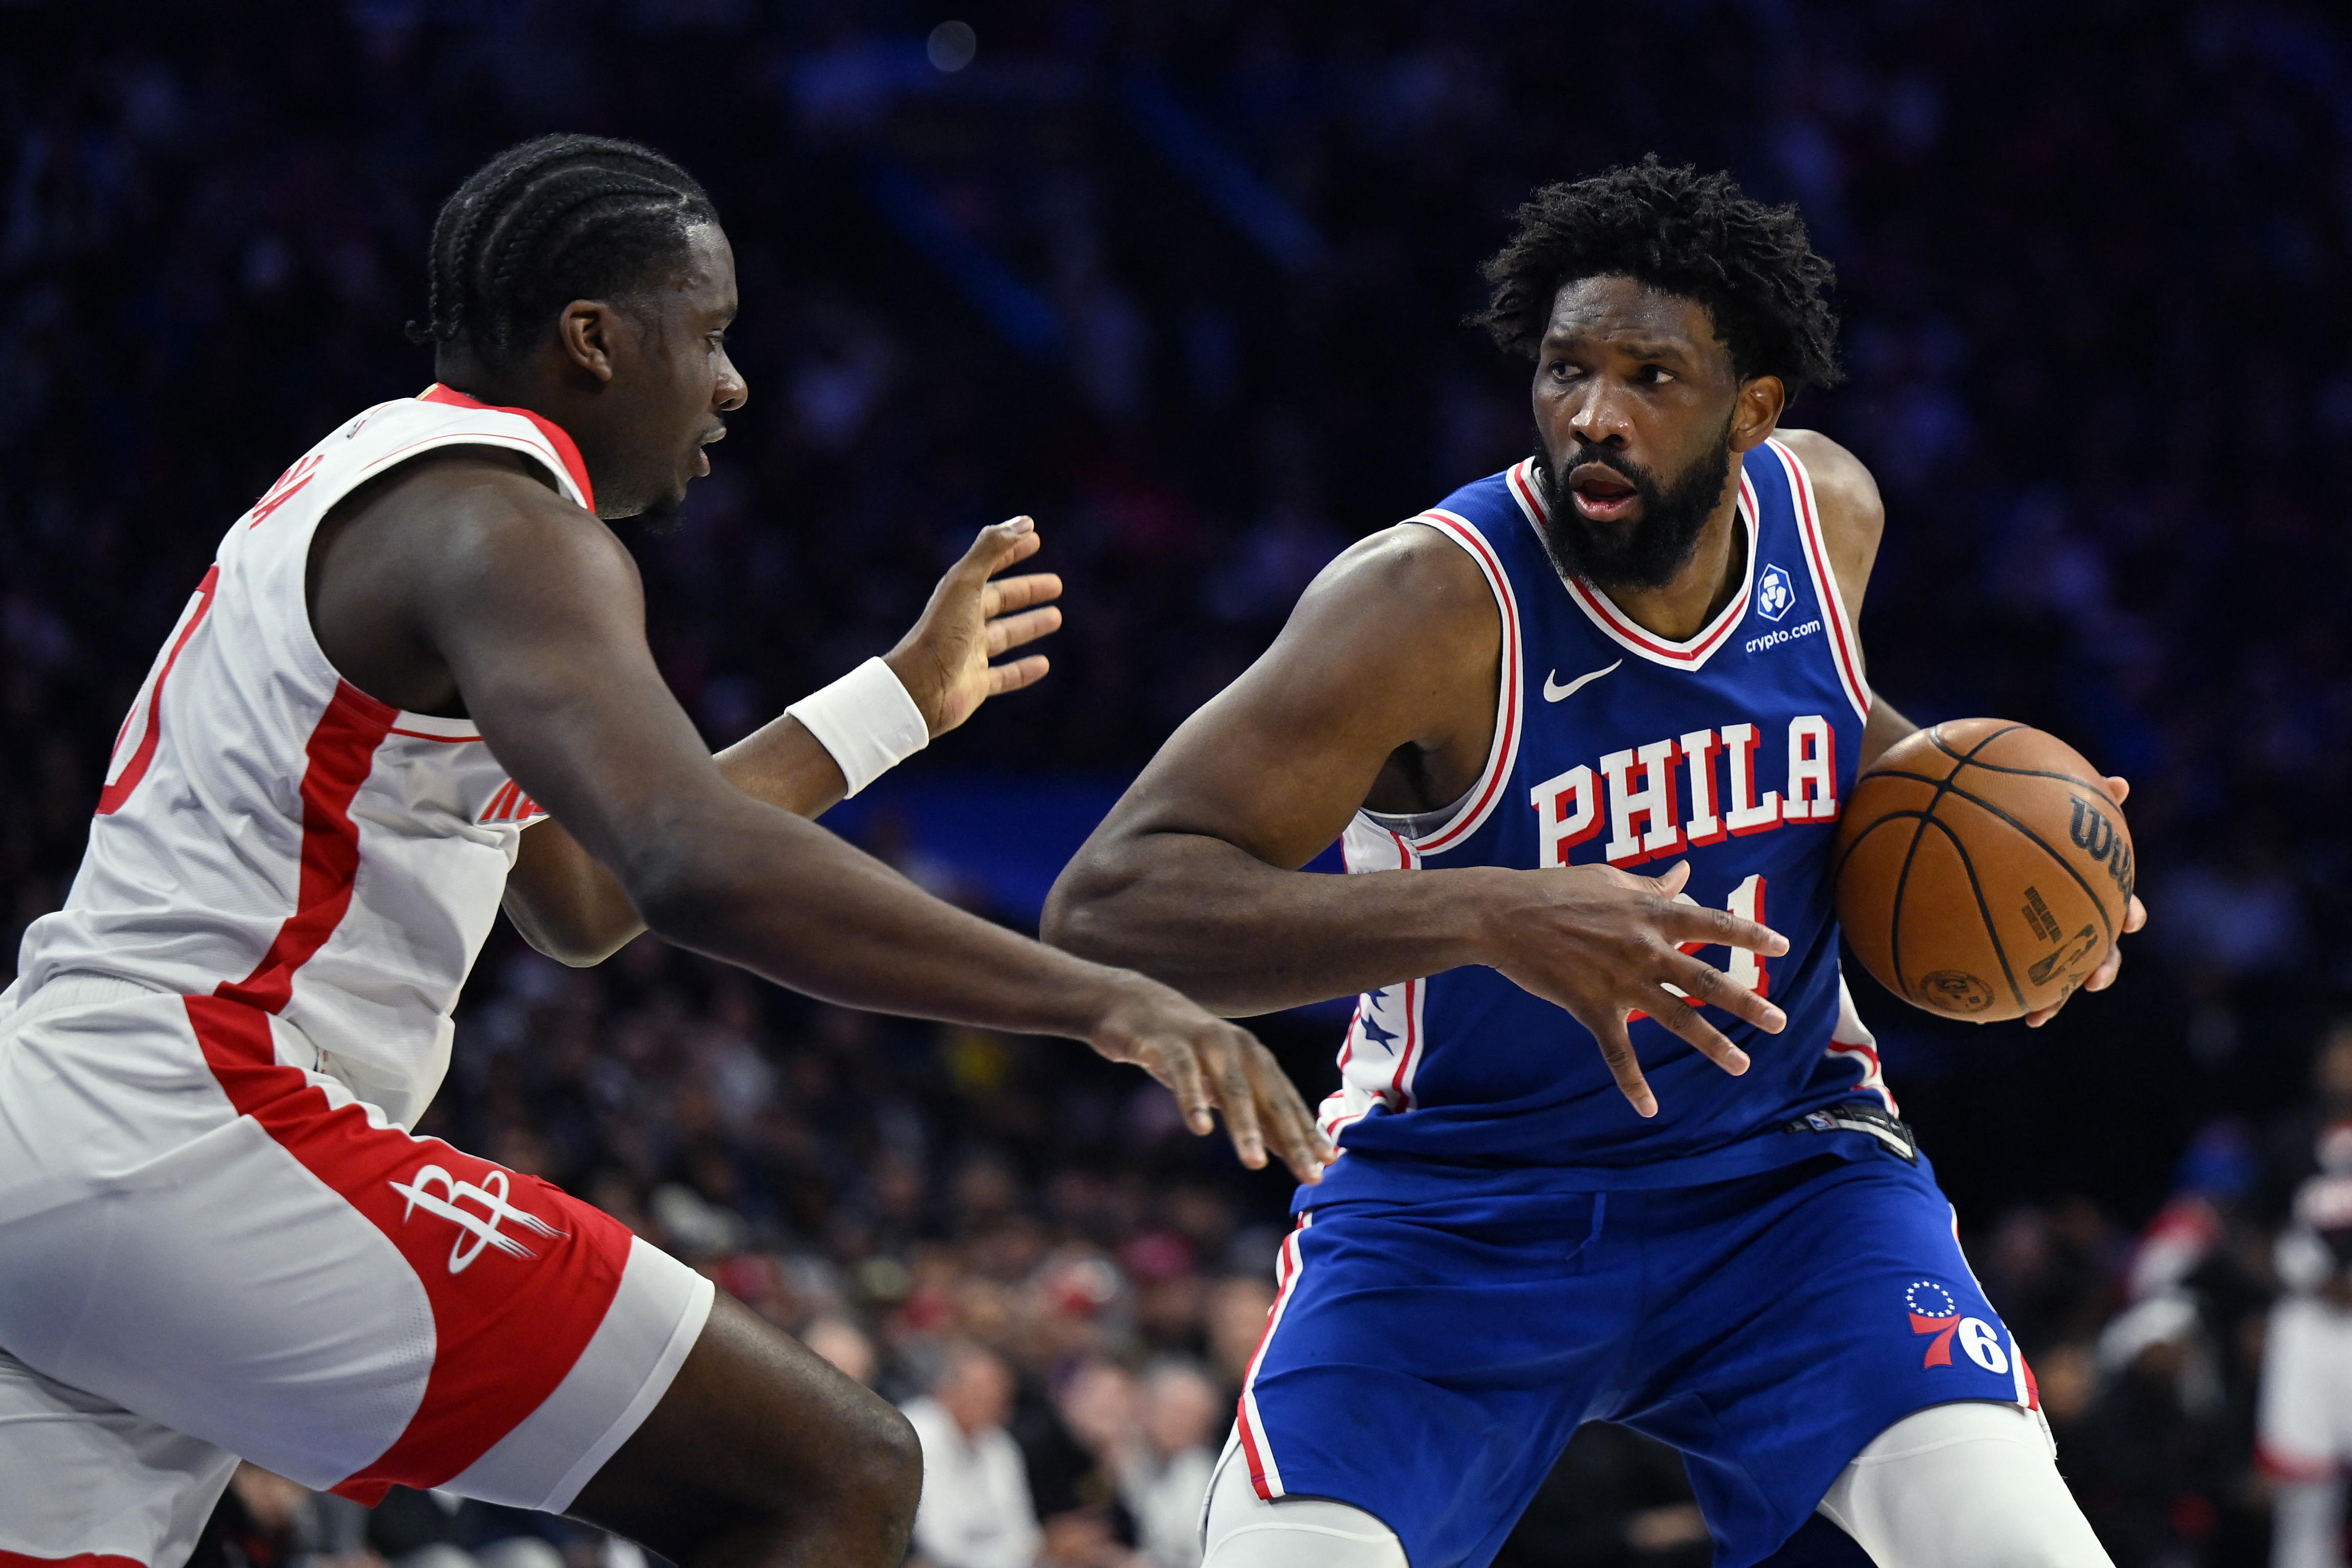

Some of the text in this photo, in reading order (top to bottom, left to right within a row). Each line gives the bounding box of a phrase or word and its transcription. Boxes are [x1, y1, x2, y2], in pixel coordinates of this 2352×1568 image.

[1746, 620, 1820, 653] crypto.com
[1530, 715, 1840, 868] PHILA
[1908, 1311, 2009, 1374] 76
